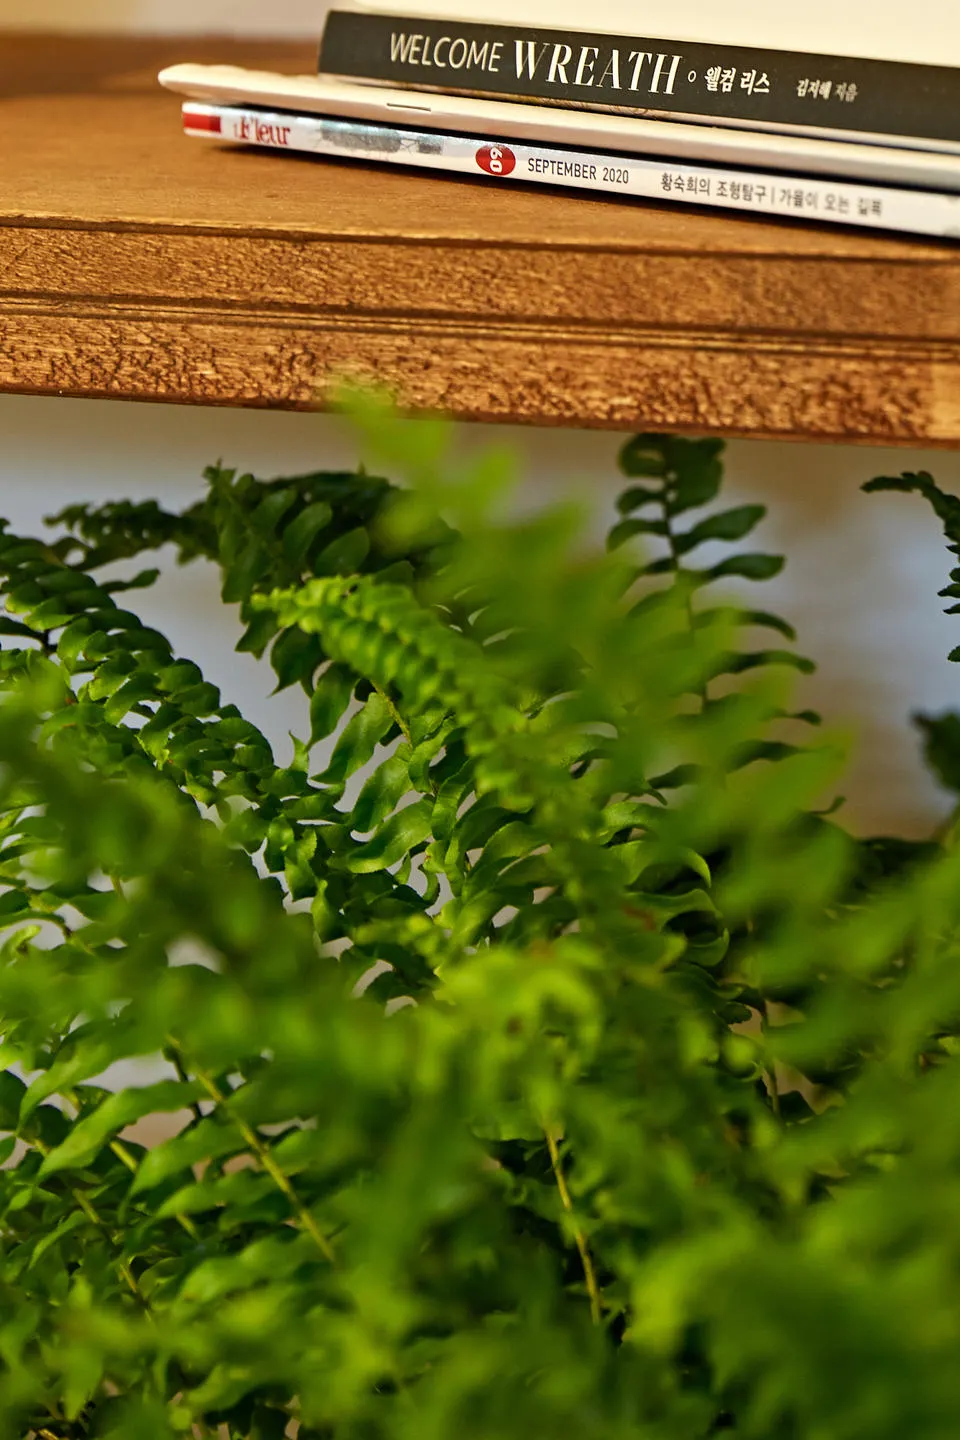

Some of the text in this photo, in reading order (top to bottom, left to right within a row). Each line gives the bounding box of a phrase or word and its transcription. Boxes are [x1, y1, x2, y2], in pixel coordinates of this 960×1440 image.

[389, 32, 684, 96] WELCOME WREATH
[704, 65, 737, 93] 웰컴
[739, 68, 771, 96] 리스
[527, 157, 630, 185] SEPTEMBER 2020
[660, 171, 711, 197] 황숙희의
